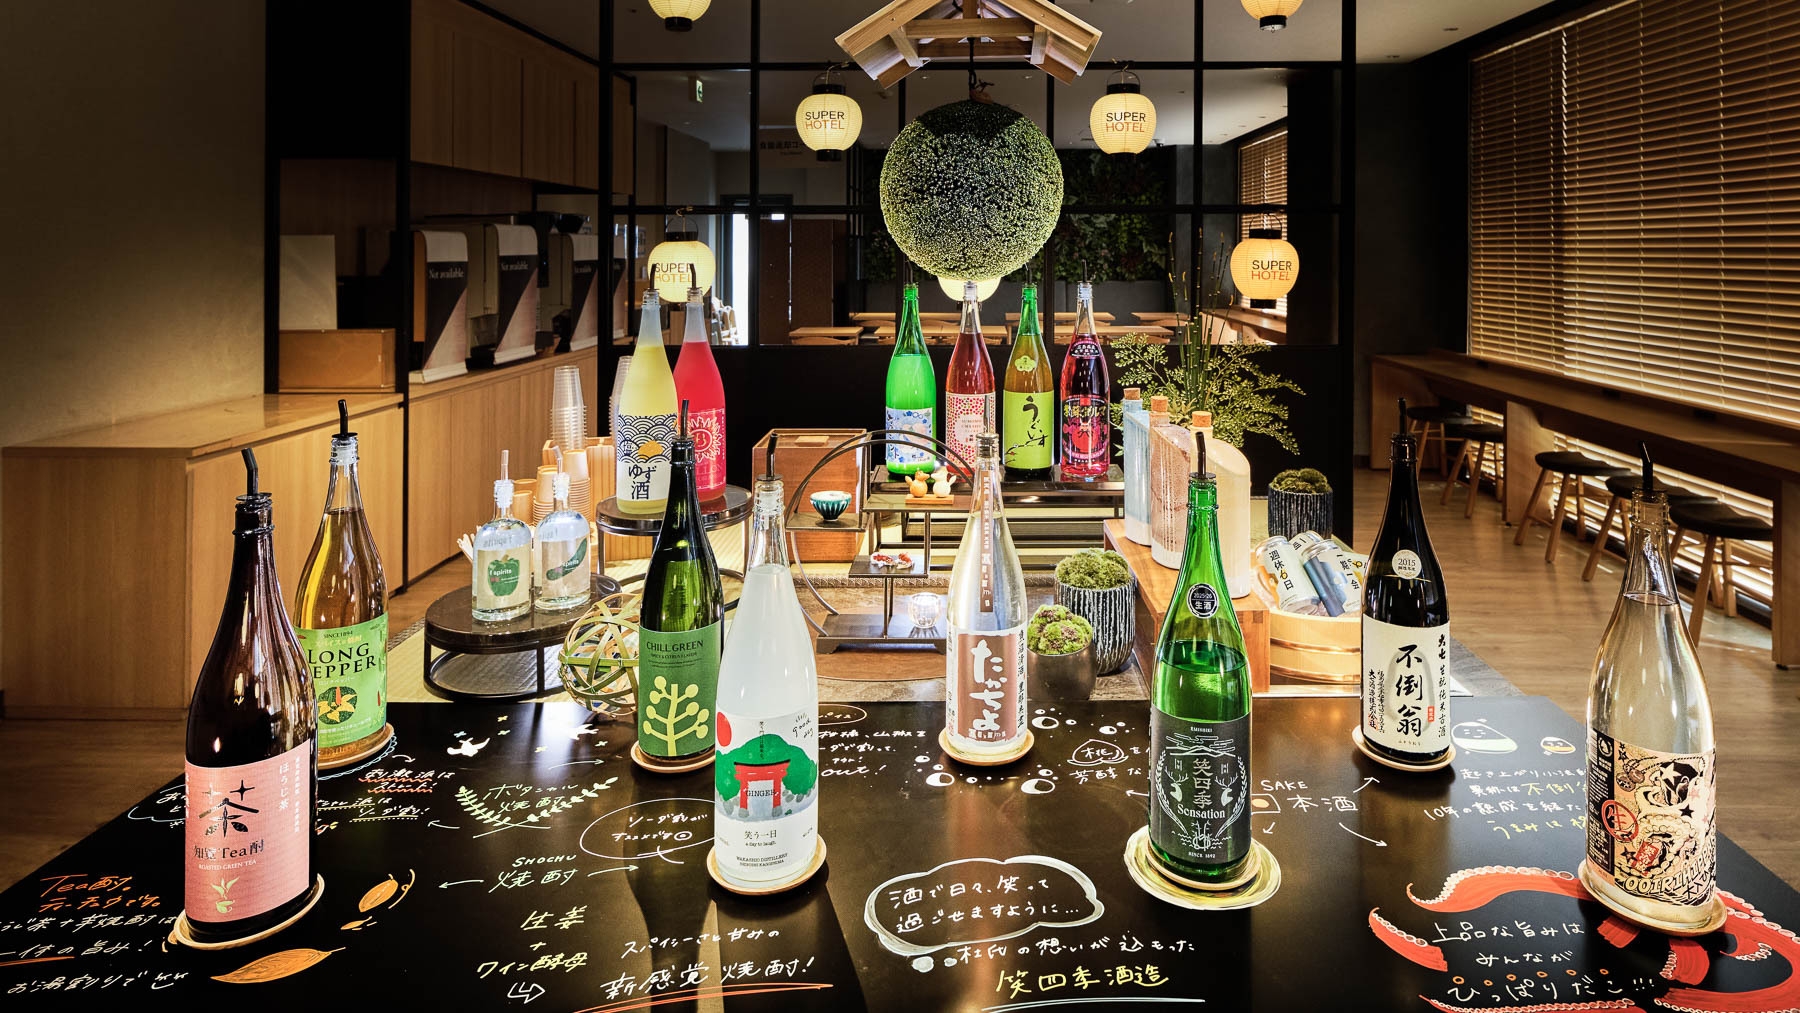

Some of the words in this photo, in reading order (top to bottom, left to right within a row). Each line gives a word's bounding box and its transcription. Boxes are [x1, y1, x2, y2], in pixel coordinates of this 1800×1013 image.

[805, 110, 845, 121] SUPER
[1106, 111, 1146, 122] SUPER
[805, 119, 845, 130] HOTEL
[1106, 121, 1145, 132] HOTEL
[1252, 260, 1292, 271] SUPER
[429, 269, 439, 279] Not
[439, 268, 465, 279] available
[1251, 270, 1291, 281] HOTEL
[628, 463, 657, 484] ゆず
[631, 481, 650, 500] 酒
[1398, 558, 1416, 567] 2015
[493, 567, 513, 577] spirits
[1195, 600, 1212, 610] 生酒
[646, 641, 671, 653] CHILL
[671, 639, 704, 652] GREEN
[307, 642, 370, 665] LONG
[313, 655, 377, 679] EPPER
[1396, 643, 1423, 738] 不倒翁
[279, 762, 290, 811] ほうじ茶
[1192, 758, 1214, 809] 笑四季
[1260, 780, 1309, 792] SAKE
[745, 789, 776, 797] GINGER
[1177, 803, 1226, 819] Sensation
[744, 829, 777, 840] 笑う一日
[223, 861, 243, 870] GREEN
[244, 858, 257, 868] TEA
[512, 855, 577, 867] SHOCHU
[488, 868, 578, 893] 焼酎
[520, 905, 588, 931] 生姜
[1432, 920, 1585, 943] 上品な旨みは
[1475, 949, 1573, 966] みんなが
[995, 964, 1170, 999] 笑四季酒造
